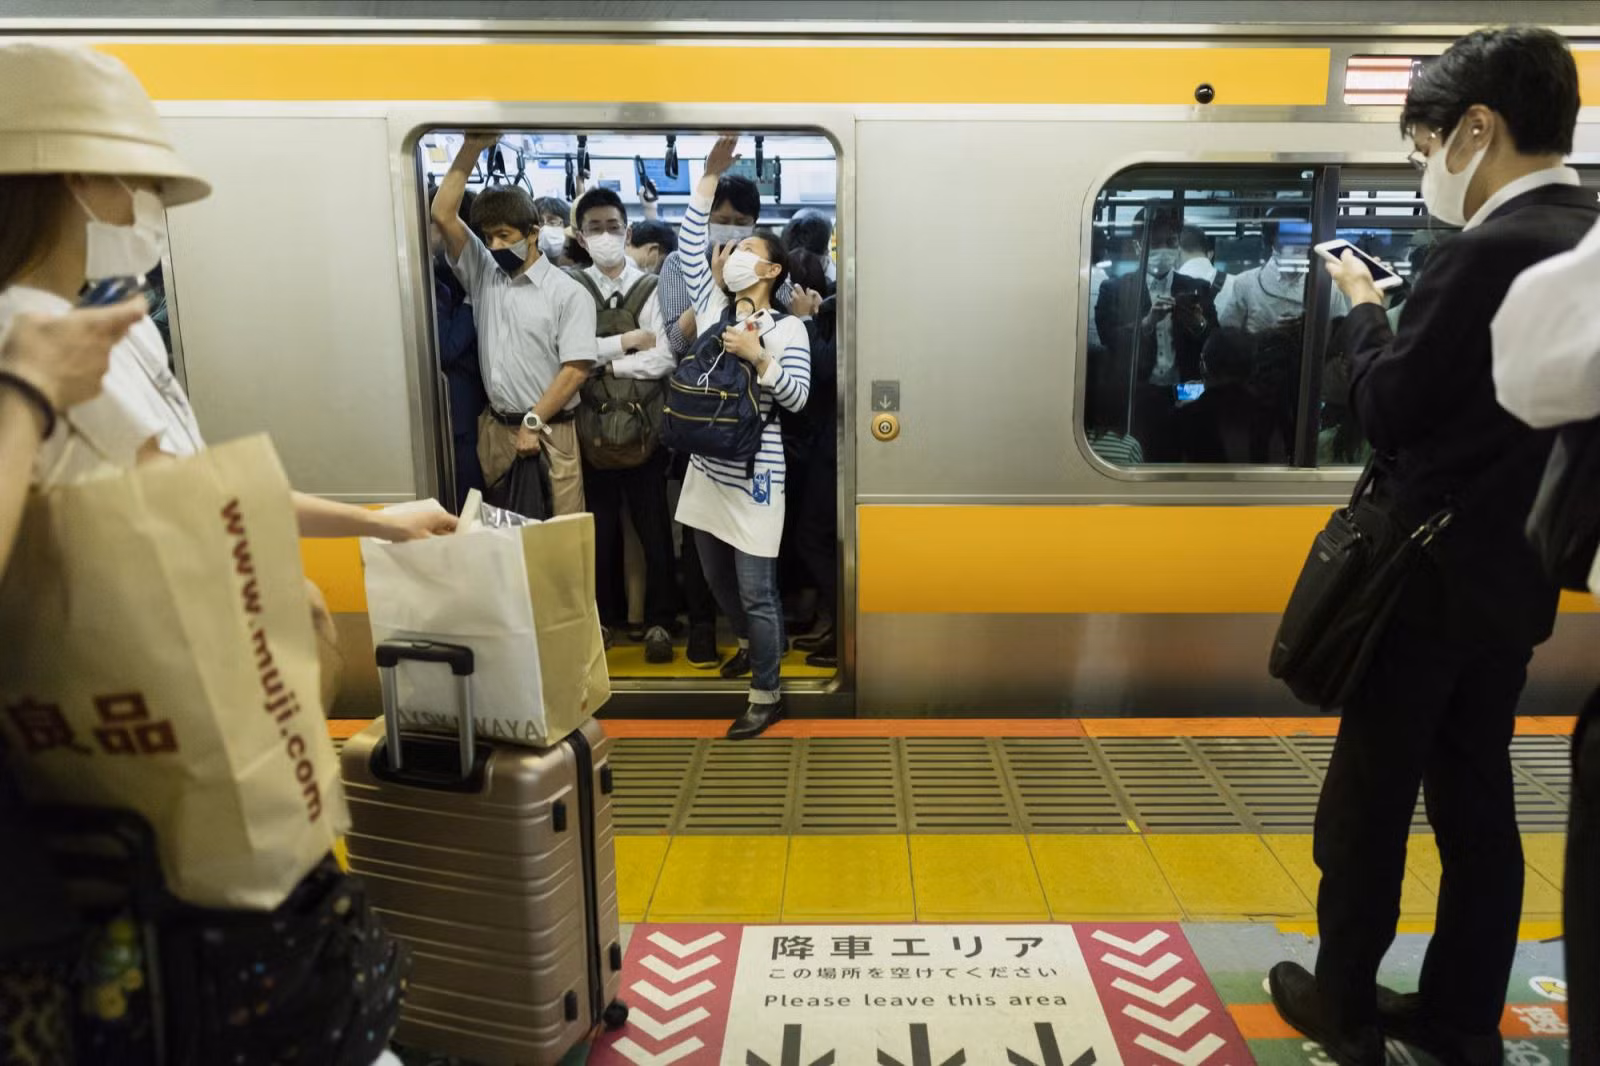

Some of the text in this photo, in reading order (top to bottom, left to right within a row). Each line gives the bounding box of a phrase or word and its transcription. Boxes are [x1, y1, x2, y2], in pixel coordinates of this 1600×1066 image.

[221, 497, 324, 823] www.muji.com
[771, 934, 1044, 960] 降車エリア
[768, 966, 1058, 980] この場所を空けてください
[764, 993, 1067, 1007] Please leave this area
